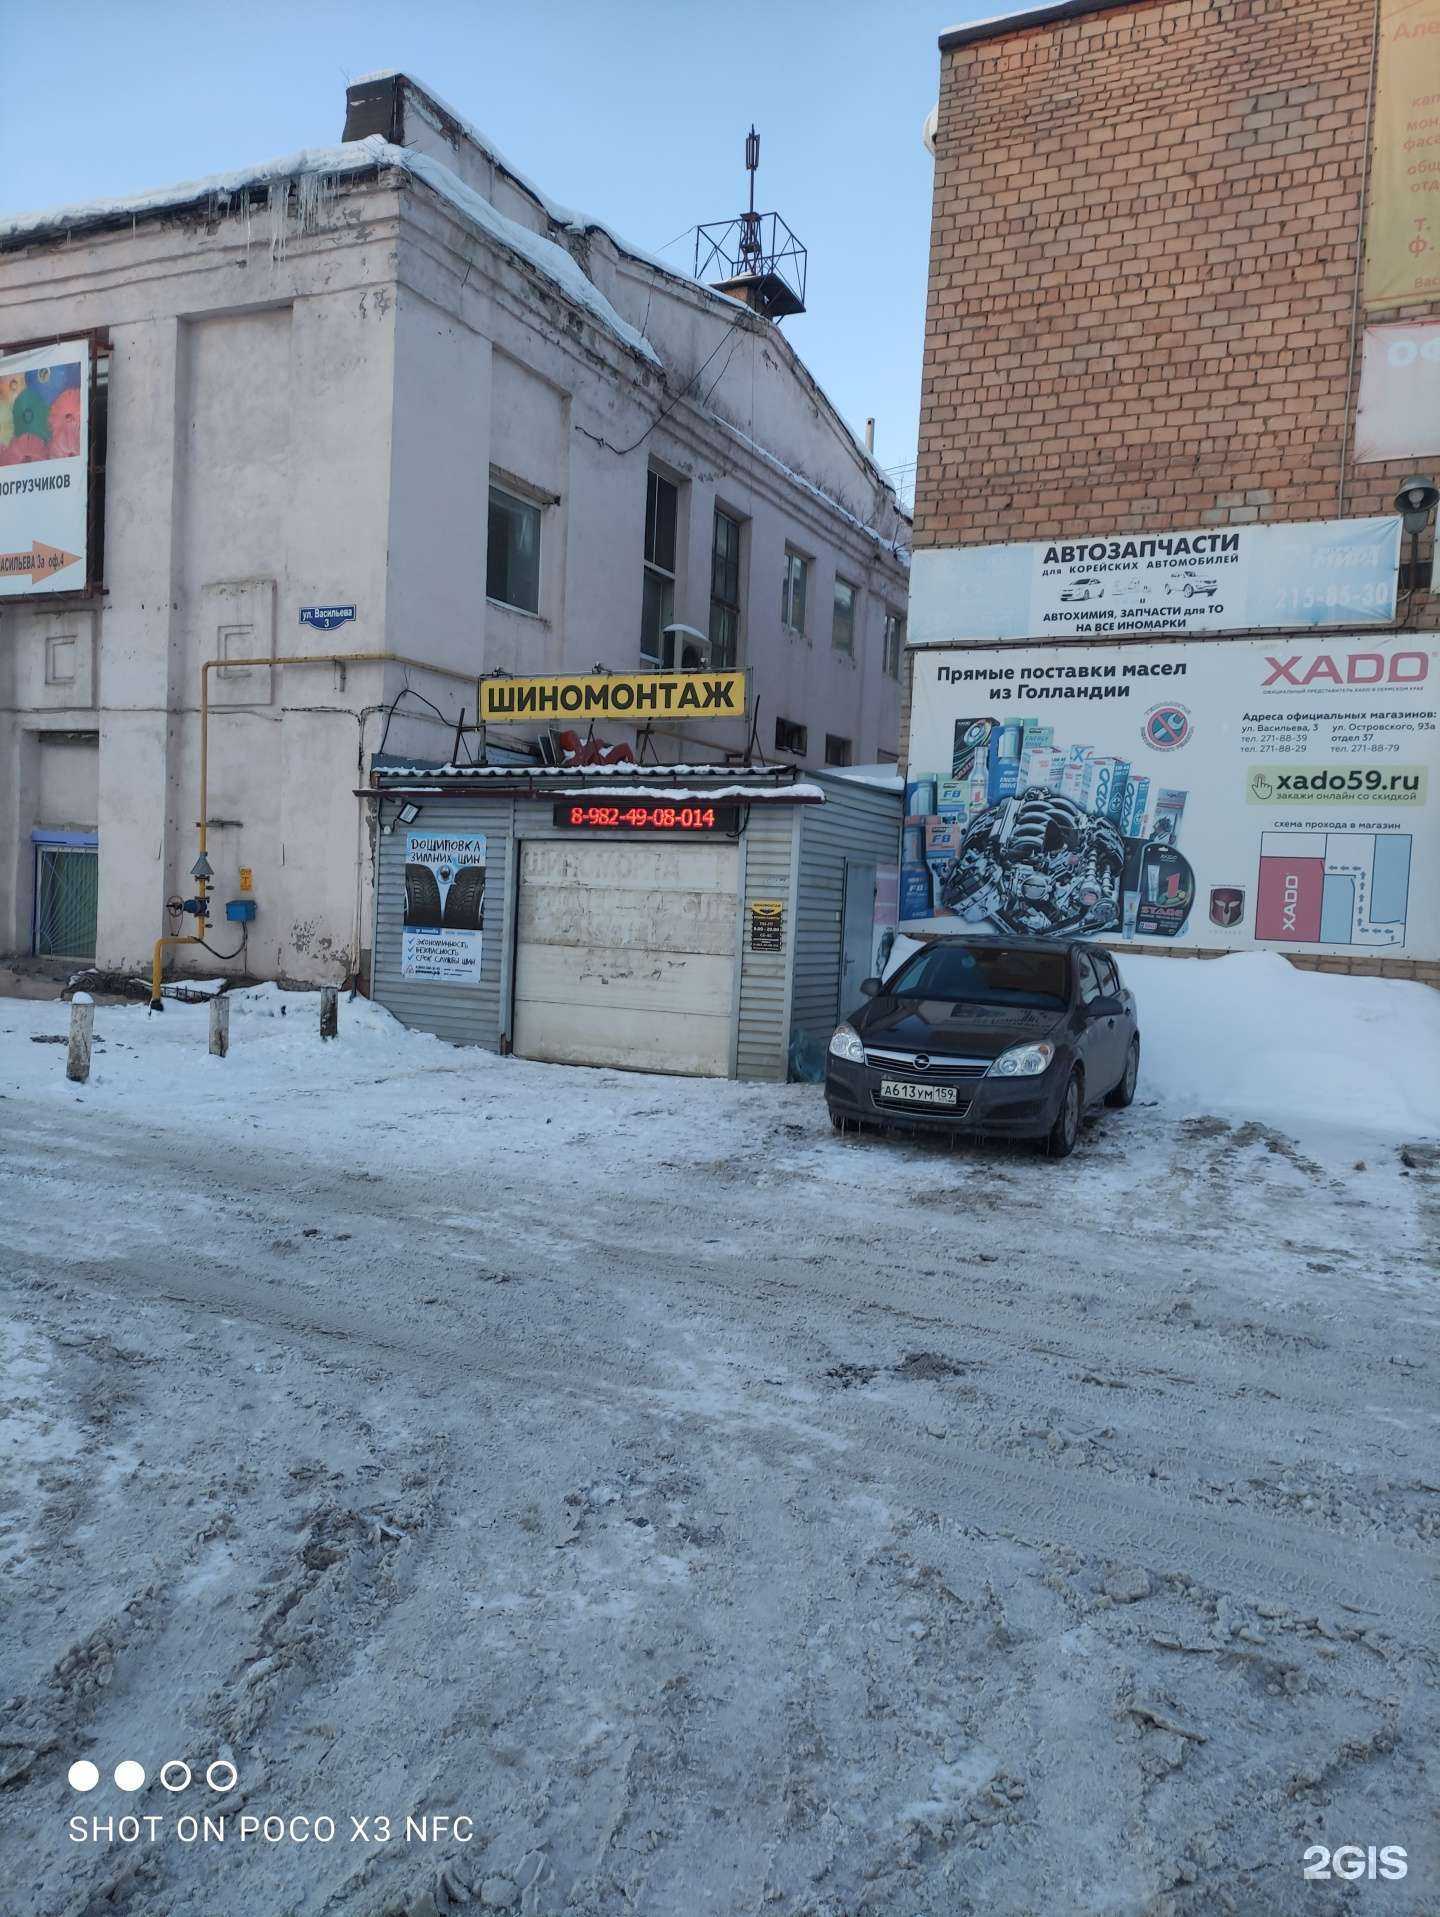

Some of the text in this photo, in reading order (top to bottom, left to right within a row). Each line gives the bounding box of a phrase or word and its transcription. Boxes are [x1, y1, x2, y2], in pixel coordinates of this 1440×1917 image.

[1043, 534, 1239, 564] АВТОЗАПЧАСТИ
[1042, 554, 1239, 577] для КОРЕЙСКИХ АВТОМОБИЛЕЙ
[1043, 604, 1224, 622] АВТОХИМИЯ, ЗАПЧАСТИ для ТО
[324, 618, 330, 628] 3
[1076, 619, 1186, 633] НА ВСЕ ИНОМАРКИ
[937, 662, 1187, 685] Прямые поставки масел
[1260, 651, 1429, 686] XADO
[488, 681, 735, 713] ШИНОМОНТАЖ
[989, 684, 1130, 701] из Голландии
[1242, 711, 1437, 722] Адреса официальных магазинов:
[1241, 723, 1319, 733] ул. Васильева, 3
[1332, 722, 1436, 733] ул. Островского, 93а
[1276, 770, 1419, 790] xado59.ru
[1276, 792, 1314, 800] закажи
[1316, 791, 1355, 800] онлайн
[1372, 791, 1417, 801] скидкой
[570, 807, 715, 828] 8-982-49-08-014
[1274, 820, 1303, 828] схема
[1305, 821, 1347, 830] прохода
[411, 838, 481, 851] ДОШИПОВКА
[410, 851, 481, 865] ЗИМНИХ ШИН
[1282, 875, 1298, 931] XADO
[935, 1088, 954, 1099] 159
